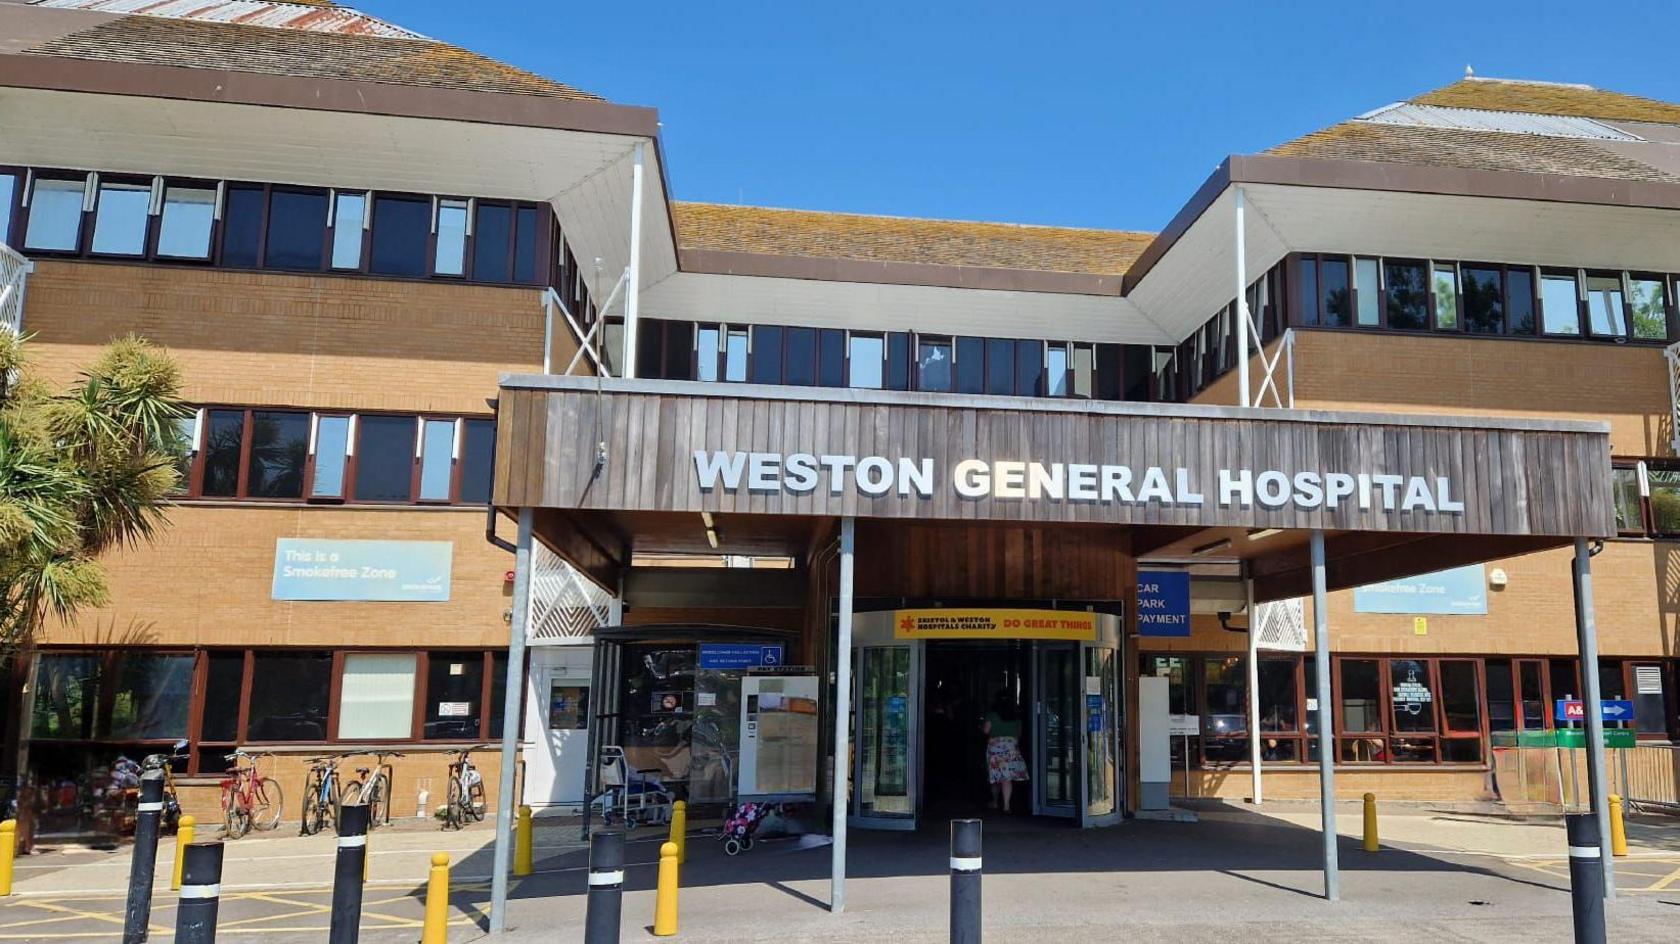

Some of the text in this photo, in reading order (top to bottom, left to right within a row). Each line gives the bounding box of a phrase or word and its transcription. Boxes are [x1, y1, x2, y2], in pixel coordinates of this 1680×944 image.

[694, 450, 1465, 513] WESTON GENERAL HOSPITAL
[285, 550, 311, 562] This
[315, 550, 326, 562] is
[283, 565, 397, 579] Smokefree Zone
[1136, 583, 1159, 593] CAR
[1418, 583, 1446, 594] Zone
[1003, 618, 1092, 631] DO GREAT THINGS
[1567, 705, 1584, 715] A&
